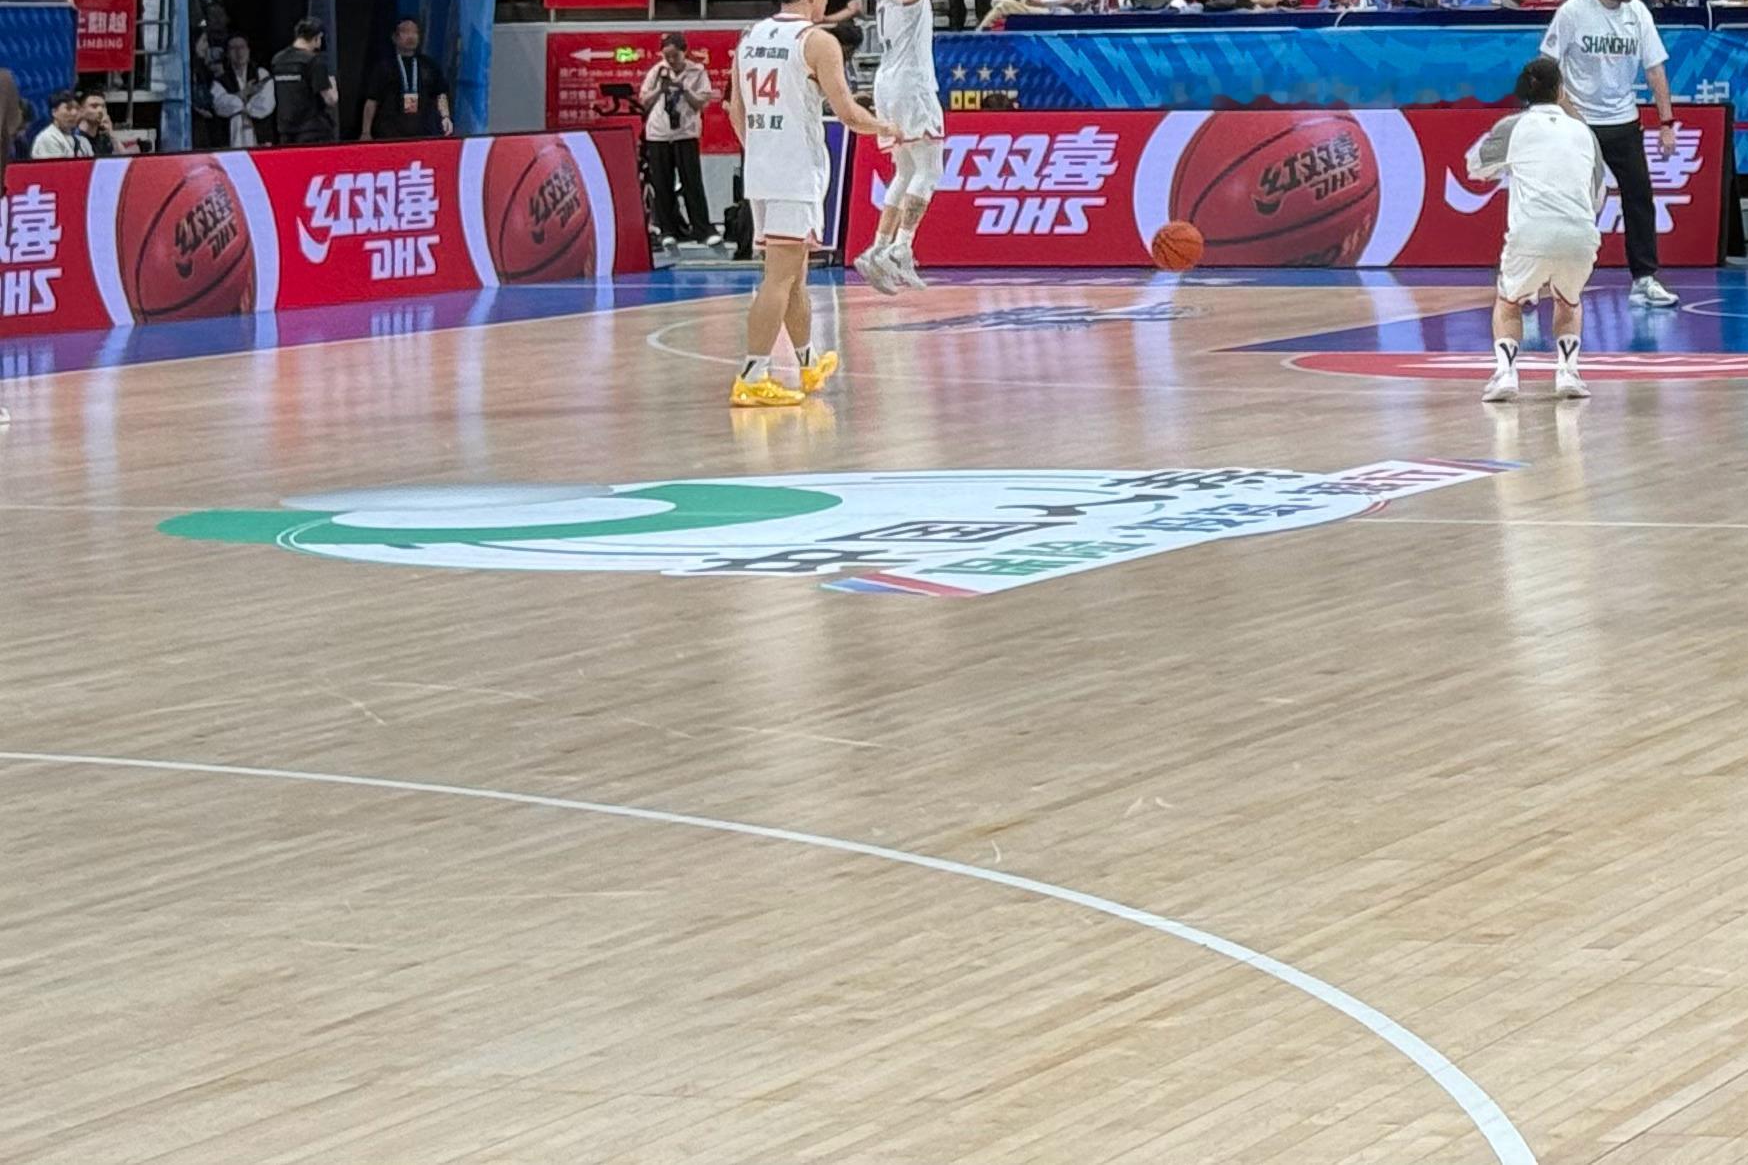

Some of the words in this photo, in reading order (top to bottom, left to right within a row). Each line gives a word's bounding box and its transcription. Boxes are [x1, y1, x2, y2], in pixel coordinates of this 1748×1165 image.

[1580, 34, 1638, 56] SHANGHAI
[746, 66, 781, 106] 14
[1257, 132, 1360, 198] 红双喜
[1310, 167, 1360, 201] DHS
[300, 160, 440, 240] 红双喜
[973, 196, 1107, 235] DHS
[0, 184, 62, 263] 喜
[363, 235, 440, 281] DHS
